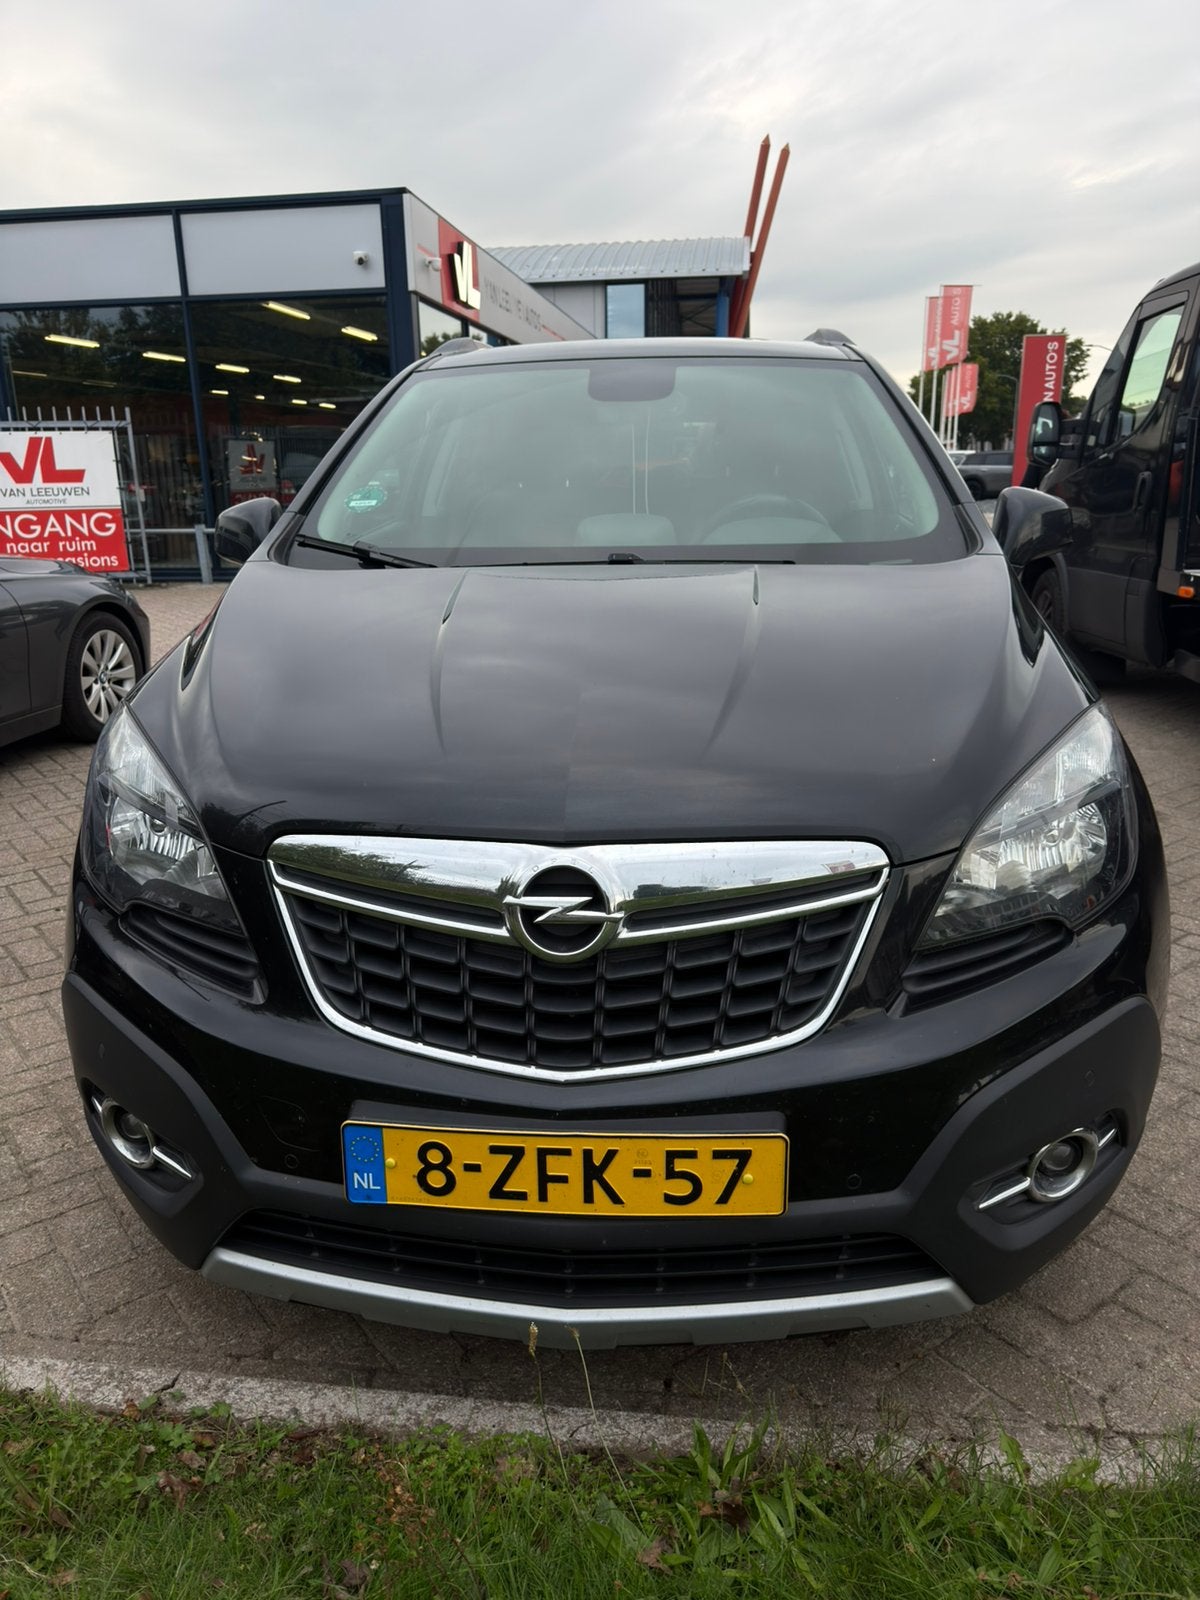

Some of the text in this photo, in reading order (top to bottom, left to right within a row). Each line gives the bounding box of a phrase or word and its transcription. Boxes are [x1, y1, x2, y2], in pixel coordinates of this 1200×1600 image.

[447, 241, 481, 311] VL
[0, 436, 86, 484] VL
[0, 486, 91, 497] VAN LEEUWEN
[6, 537, 96, 554] naar ruim
[353, 1172, 381, 1190] NL
[416, 1139, 753, 1206] 8-ZFK-57
